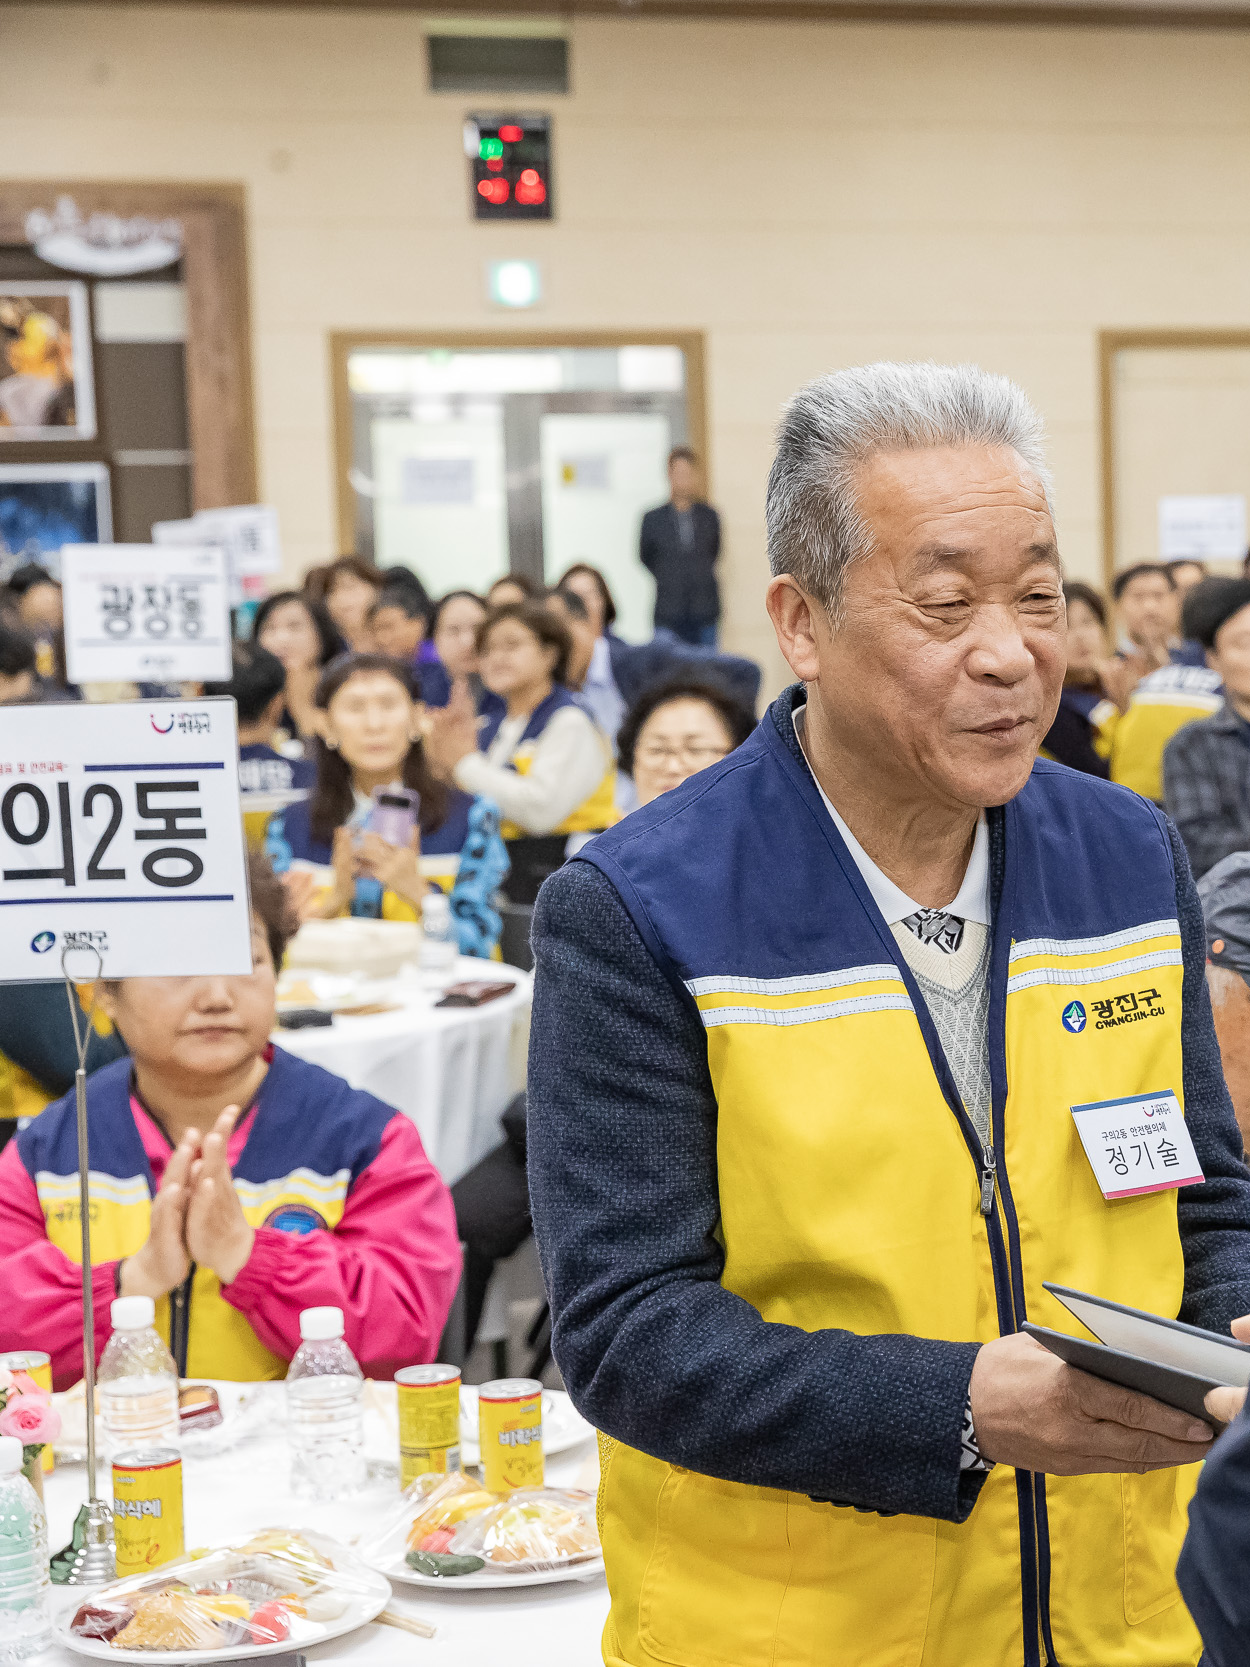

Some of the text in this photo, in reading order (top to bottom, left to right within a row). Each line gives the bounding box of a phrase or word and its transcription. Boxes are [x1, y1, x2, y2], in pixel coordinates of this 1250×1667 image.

[100, 584, 202, 638] 광장동
[1, 781, 207, 888] 의2동
[1091, 988, 1162, 1019] 광진구
[1095, 1006, 1165, 1030] GWANGJIN-GU
[1101, 1121, 1167, 1141] 구의2동 안전협의체
[1105, 1137, 1180, 1175] 정기술
